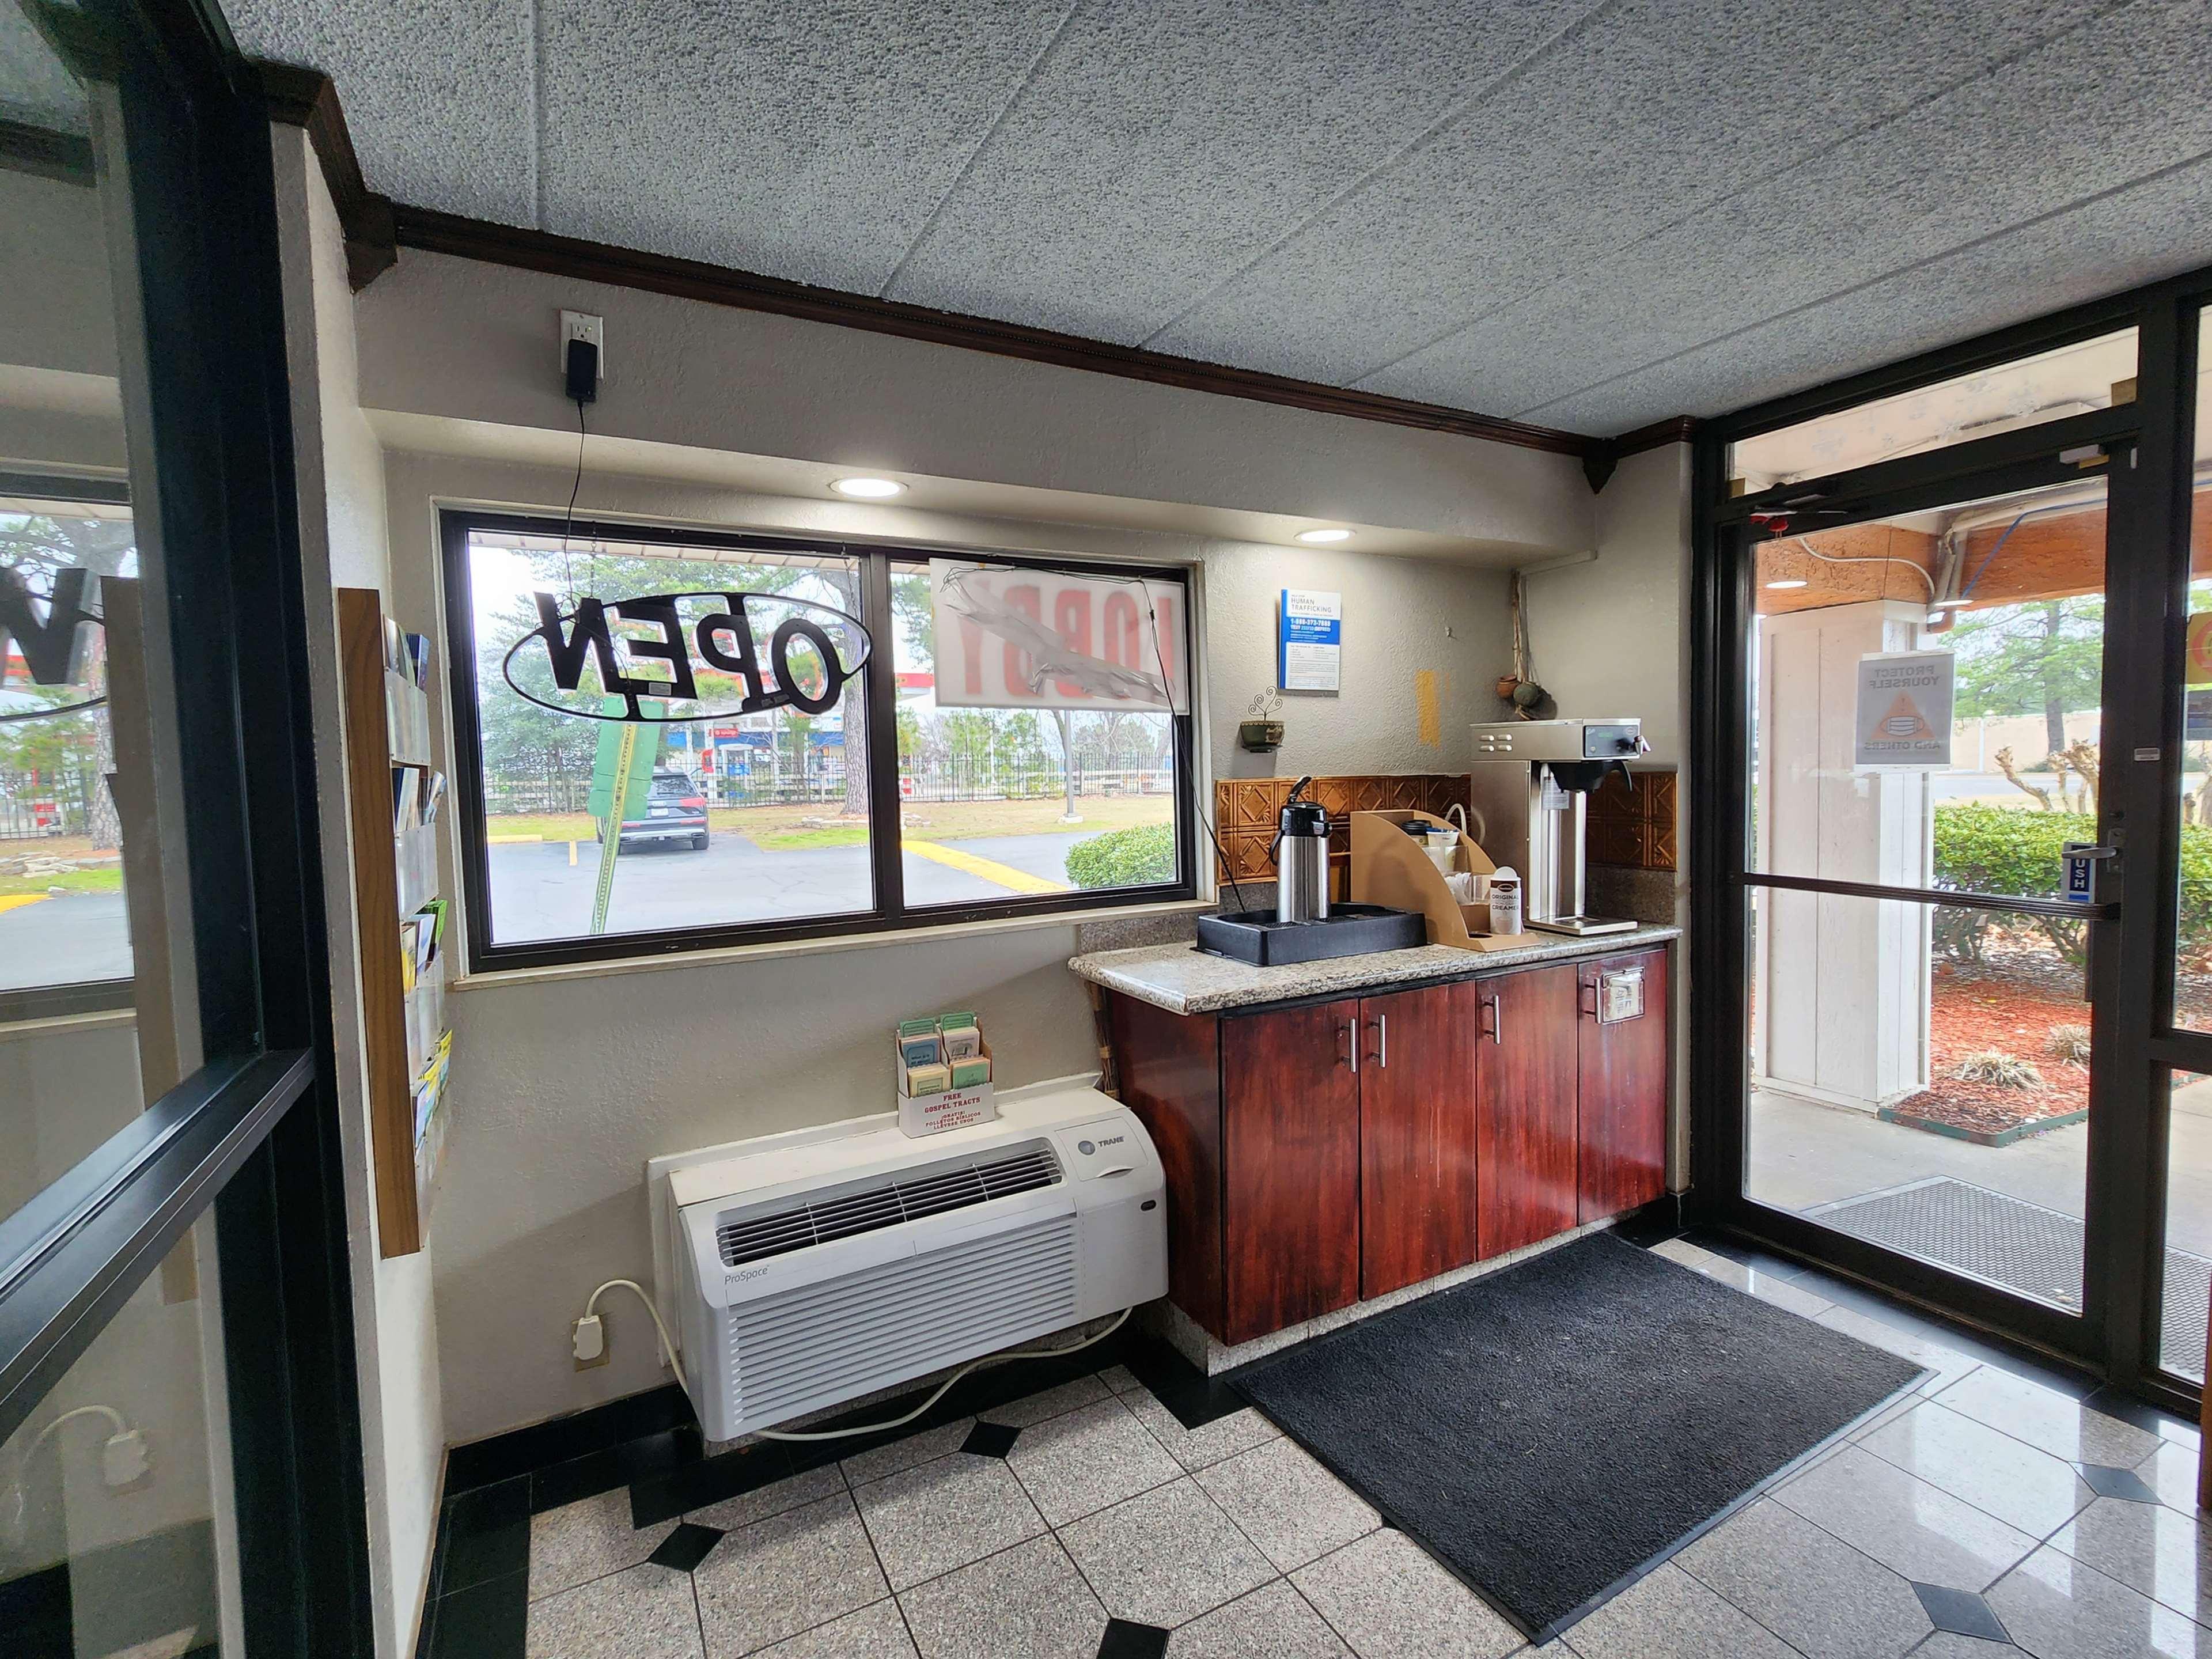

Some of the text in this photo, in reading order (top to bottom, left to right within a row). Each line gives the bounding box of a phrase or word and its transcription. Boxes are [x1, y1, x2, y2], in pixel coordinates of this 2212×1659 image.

[1291, 604, 1332, 613] TRAFFICKING
[2074, 858, 2086, 888] USH
[943, 1092, 962, 1101] FREE
[924, 1097, 980, 1113] GOSPEL TRACTS
[1098, 1136, 1124, 1147] TRANE
[724, 1267, 768, 1285] ProSpace
